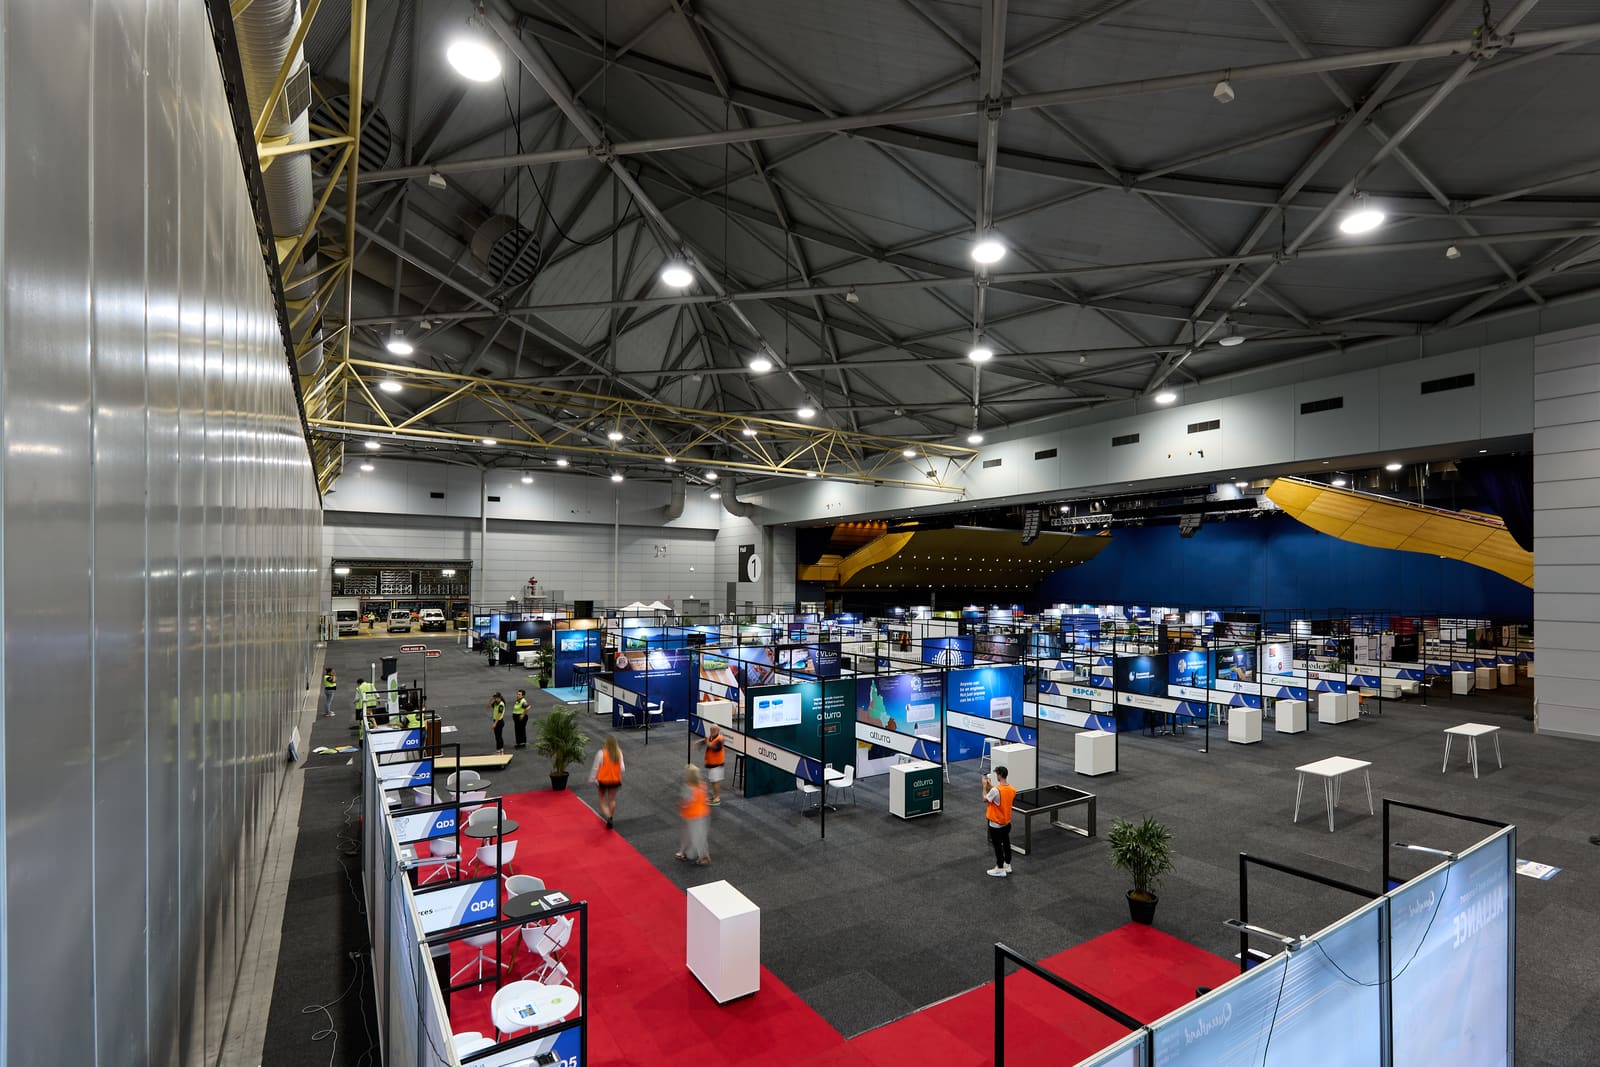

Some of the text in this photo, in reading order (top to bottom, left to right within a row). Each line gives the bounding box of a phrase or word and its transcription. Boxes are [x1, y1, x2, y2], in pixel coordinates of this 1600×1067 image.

[752, 559, 756, 578] 1
[1072, 687, 1094, 696] RSPCA
[436, 820, 455, 828] QD3
[471, 899, 495, 912] QD4
